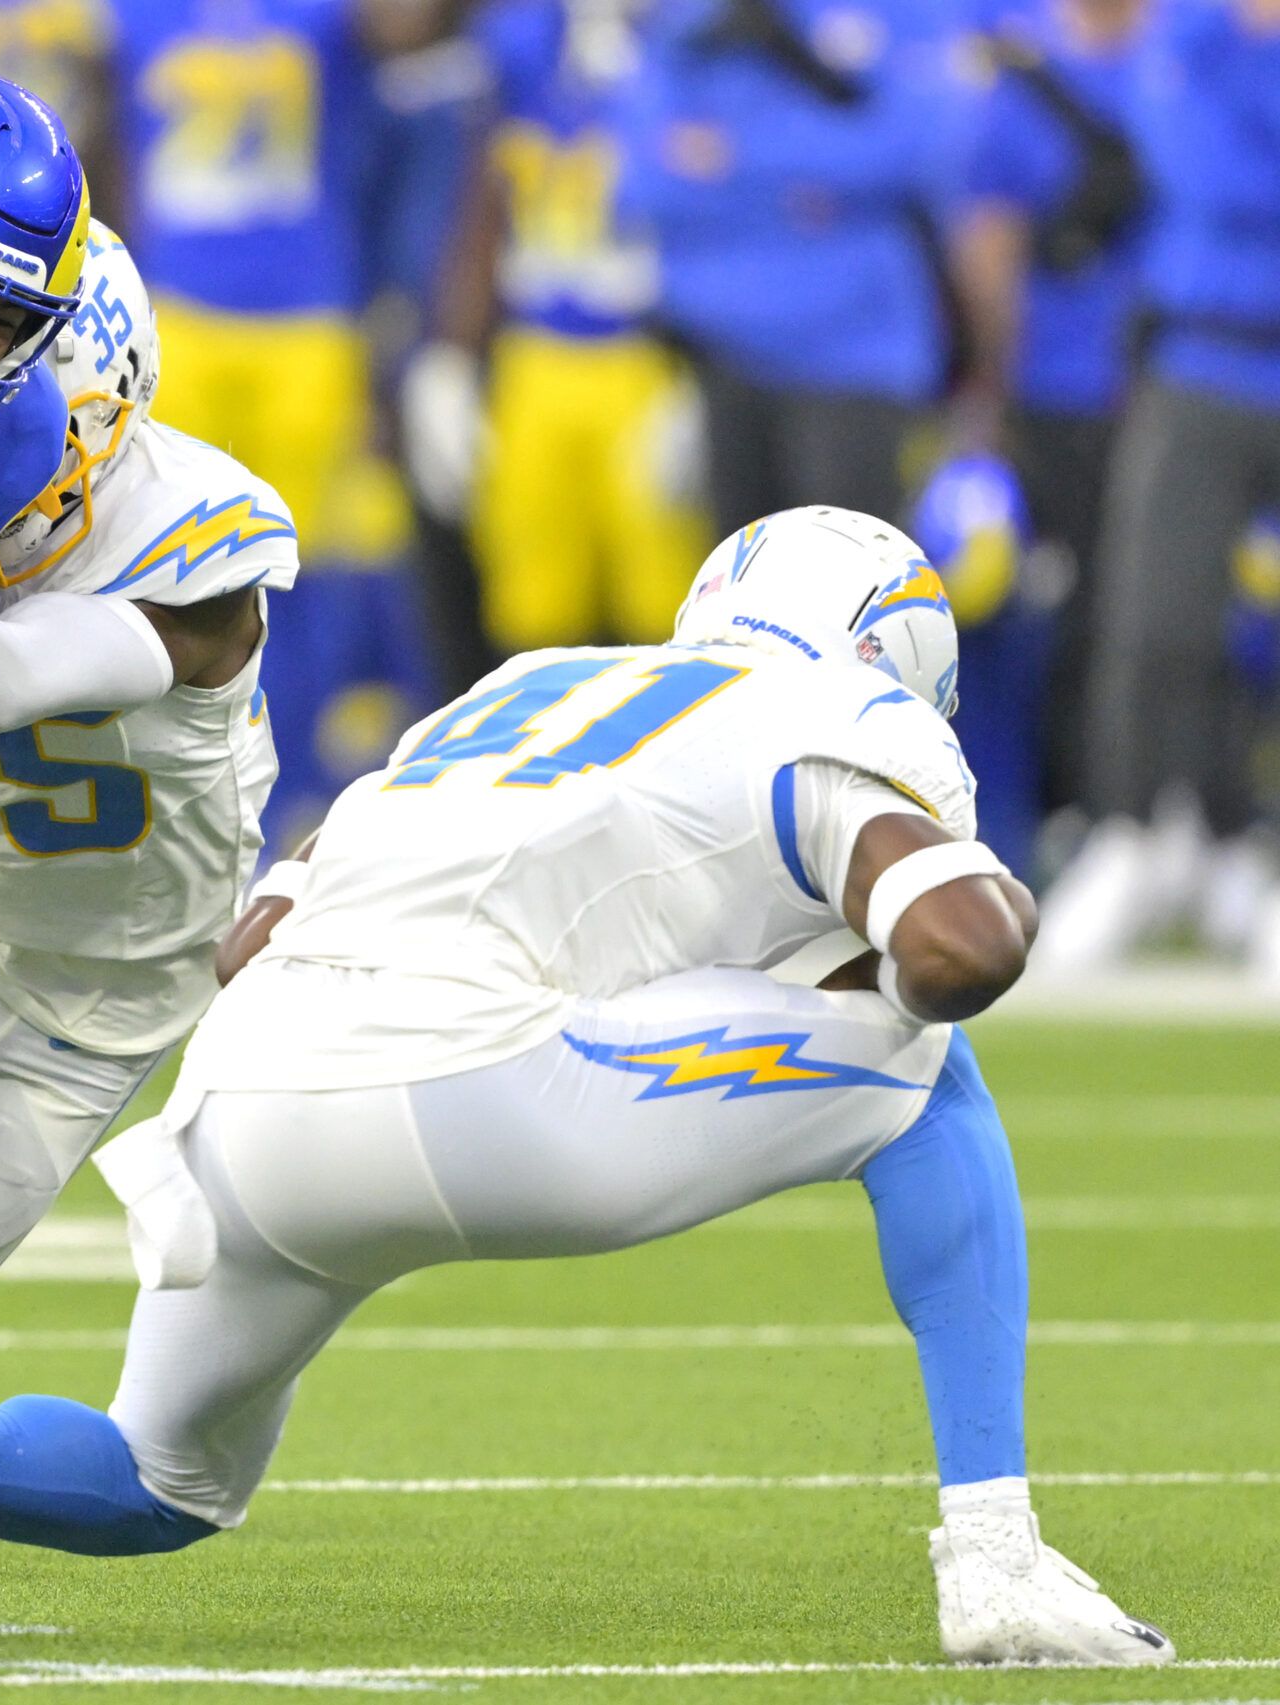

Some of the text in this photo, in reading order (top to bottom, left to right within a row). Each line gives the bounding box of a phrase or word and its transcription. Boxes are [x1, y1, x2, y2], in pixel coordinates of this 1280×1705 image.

[72, 275, 133, 375] 35
[732, 616, 823, 661] CHARGERS
[380, 657, 753, 790] 41
